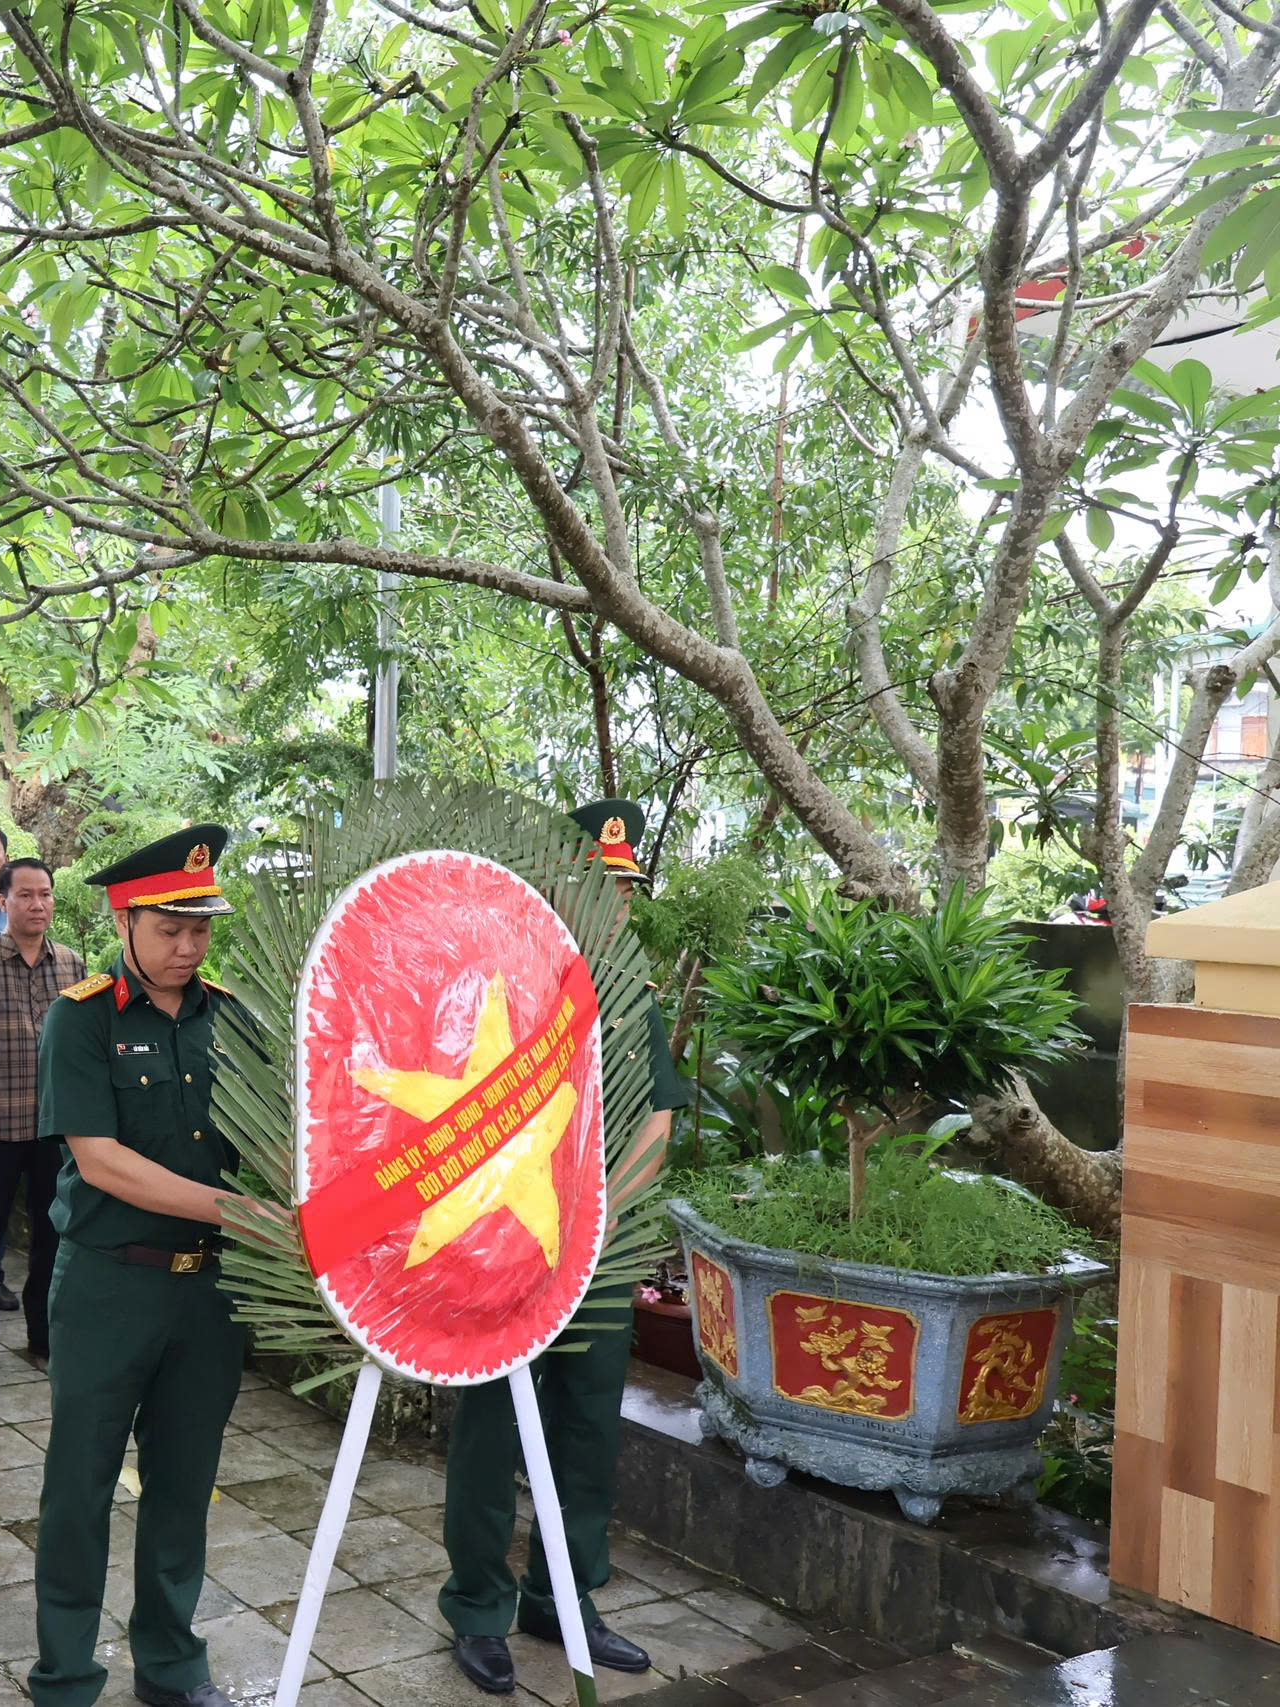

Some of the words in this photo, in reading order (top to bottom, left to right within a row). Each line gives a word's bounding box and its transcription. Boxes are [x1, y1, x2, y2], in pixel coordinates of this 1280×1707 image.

[374, 1159, 411, 1190] ĐẢNG
[401, 1144, 425, 1169] ỦY
[424, 1123, 456, 1157] HĐND
[455, 1100, 483, 1132] UBND
[481, 1069, 519, 1109] UBMTTQ
[513, 1052, 534, 1080] VIỆT
[530, 1035, 551, 1066] NAM
[415, 1170, 444, 1201] ĐỜI
[438, 1154, 464, 1185] ĐỜI
[458, 1131, 485, 1168] NHỚ
[481, 1121, 502, 1148] ƠN
[497, 1104, 521, 1134] CÁC
[518, 1084, 542, 1116] ANH
[536, 1061, 560, 1097] HÙNG
